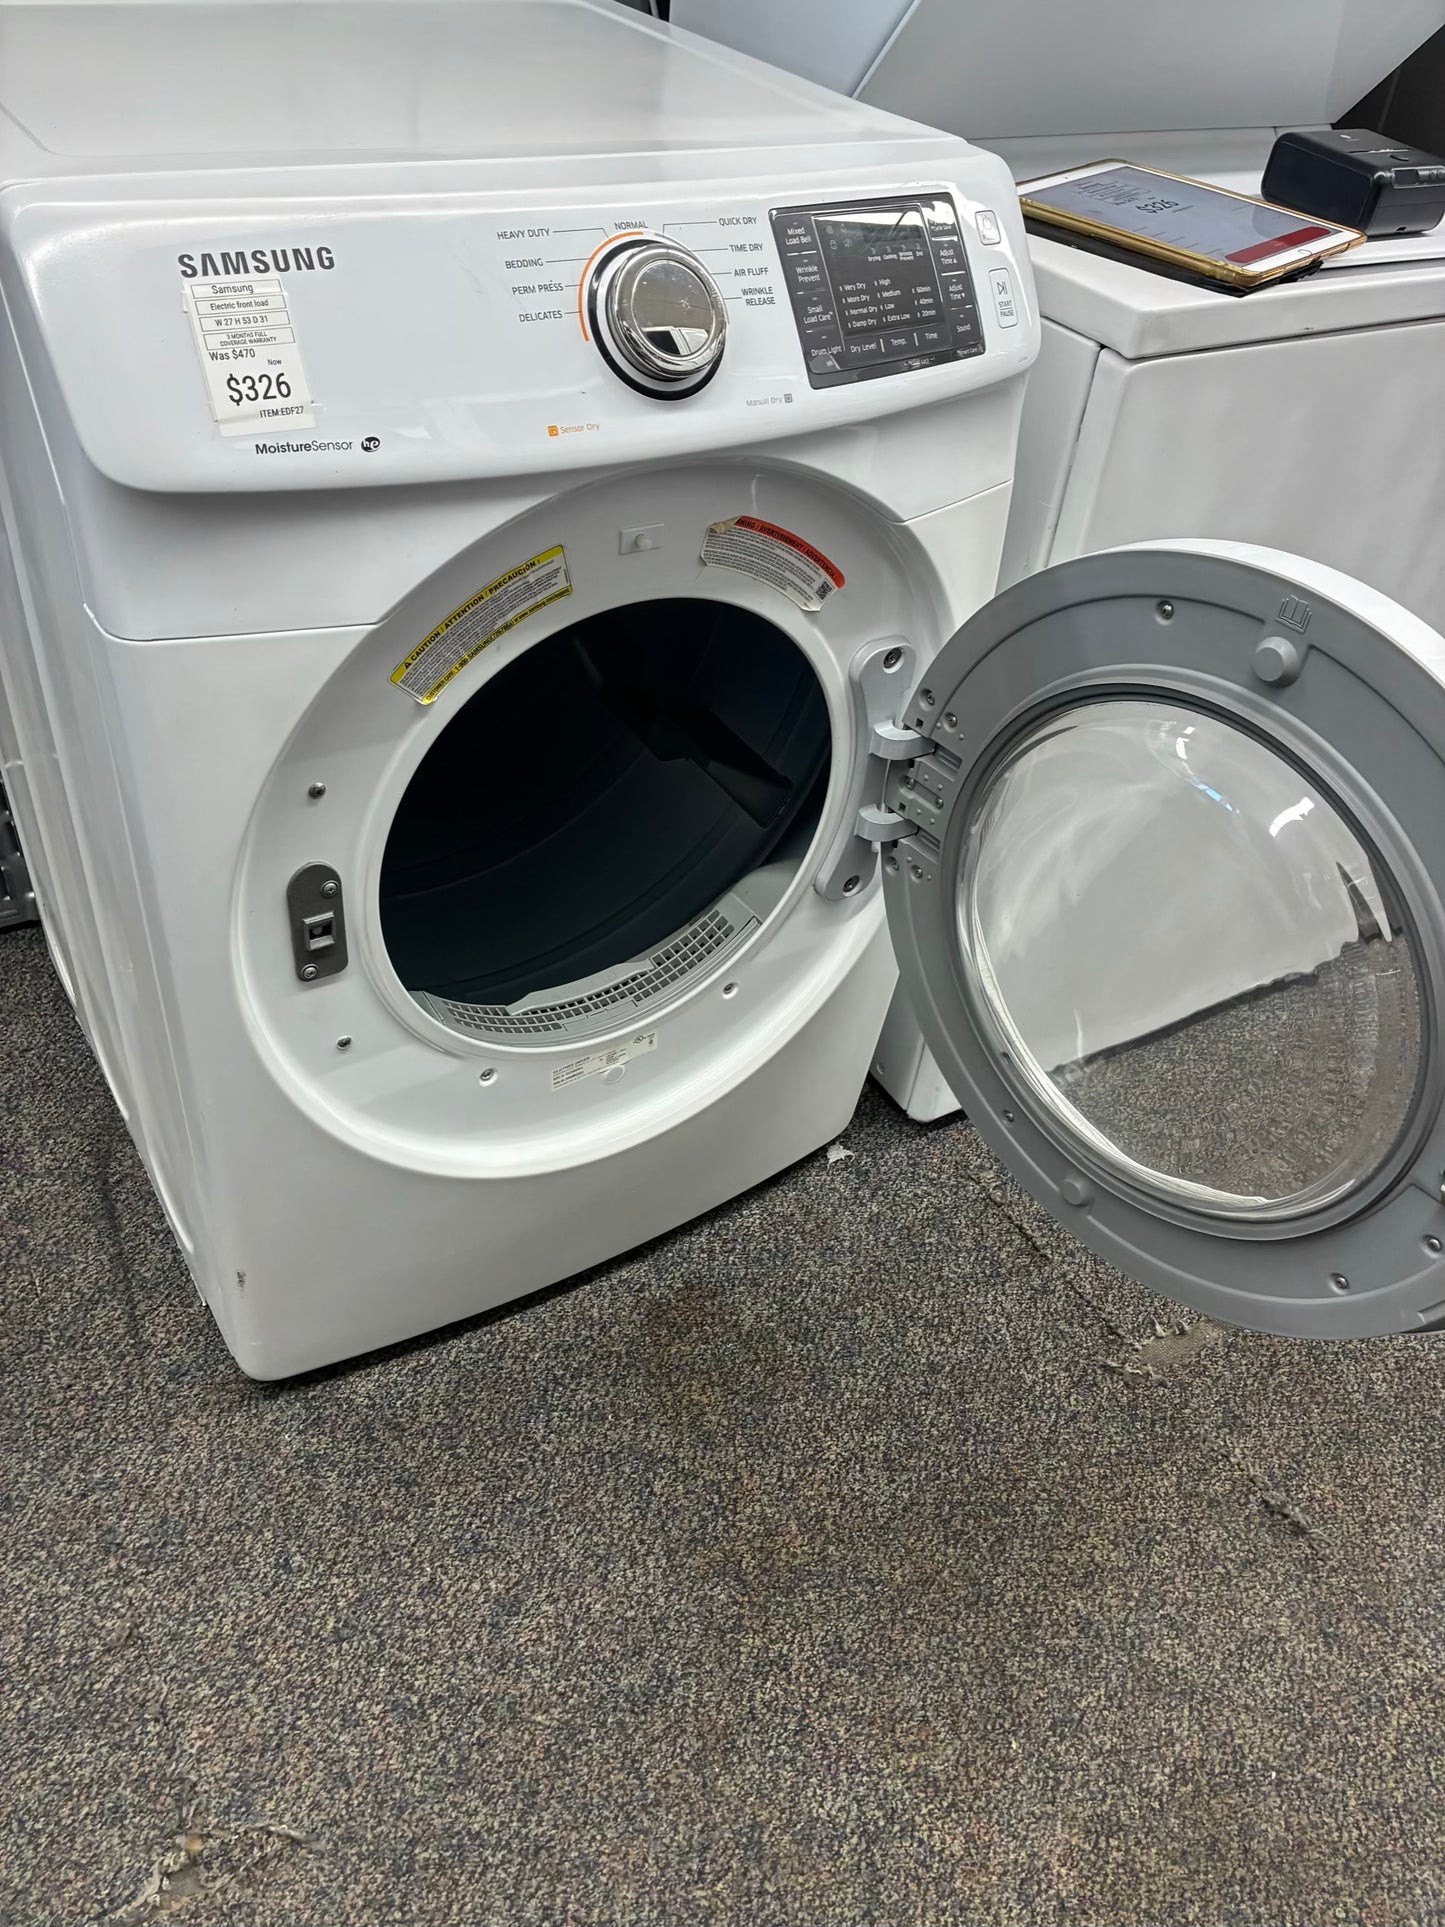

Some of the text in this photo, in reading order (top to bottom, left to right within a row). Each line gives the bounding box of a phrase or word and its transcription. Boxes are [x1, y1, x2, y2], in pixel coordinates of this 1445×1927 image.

[1136, 199, 1179, 214] $326
[614, 221, 648, 230] NORMAL
[718, 216, 757, 227] QUICK DRY
[497, 228, 550, 240] HEAVY DUTY
[787, 227, 805, 235] Mixed
[785, 235, 812, 245] Load Bell
[729, 243, 763, 252] TIME DRY
[177, 246, 335, 278] SAMSUNG
[505, 258, 544, 269] BEDDING
[734, 267, 769, 277] AIR FLUFF
[795, 264, 818, 274] Wrinkle
[798, 274, 821, 283] Prevent
[879, 278, 891, 286] High
[211, 284, 254, 294] Samsung
[512, 282, 564, 295] PERM PRESS
[741, 286, 773, 296] WRINKLE
[949, 284, 963, 292] Adjust
[210, 299, 269, 310] Electric front load
[745, 297, 775, 306] RELEASE
[807, 305, 824, 314] Small
[850, 307, 868, 315] Normal
[1000, 309, 1014, 317] PAUSE
[242, 316, 252, 324] 53
[260, 315, 268, 323] 31
[519, 310, 563, 322] DELICATES
[803, 315, 818, 324] Load
[956, 324, 971, 333] Sound
[220, 339, 248, 347] COVERAGE
[850, 342, 877, 353] Dry Level
[209, 348, 255, 361] Was $470
[811, 345, 842, 356] Drum Light
[226, 372, 292, 406] $326
[746, 396, 782, 407] Manual Dry
[260, 406, 304, 418] ITEM:EDF27
[560, 423, 600, 434] Sensor Dry
[255, 439, 353, 455] MoistureSensor
[410, 630, 441, 661] CAUTION
[445, 594, 485, 628] ATTENTION
[488, 560, 536, 594] PRECAUCIÓN
